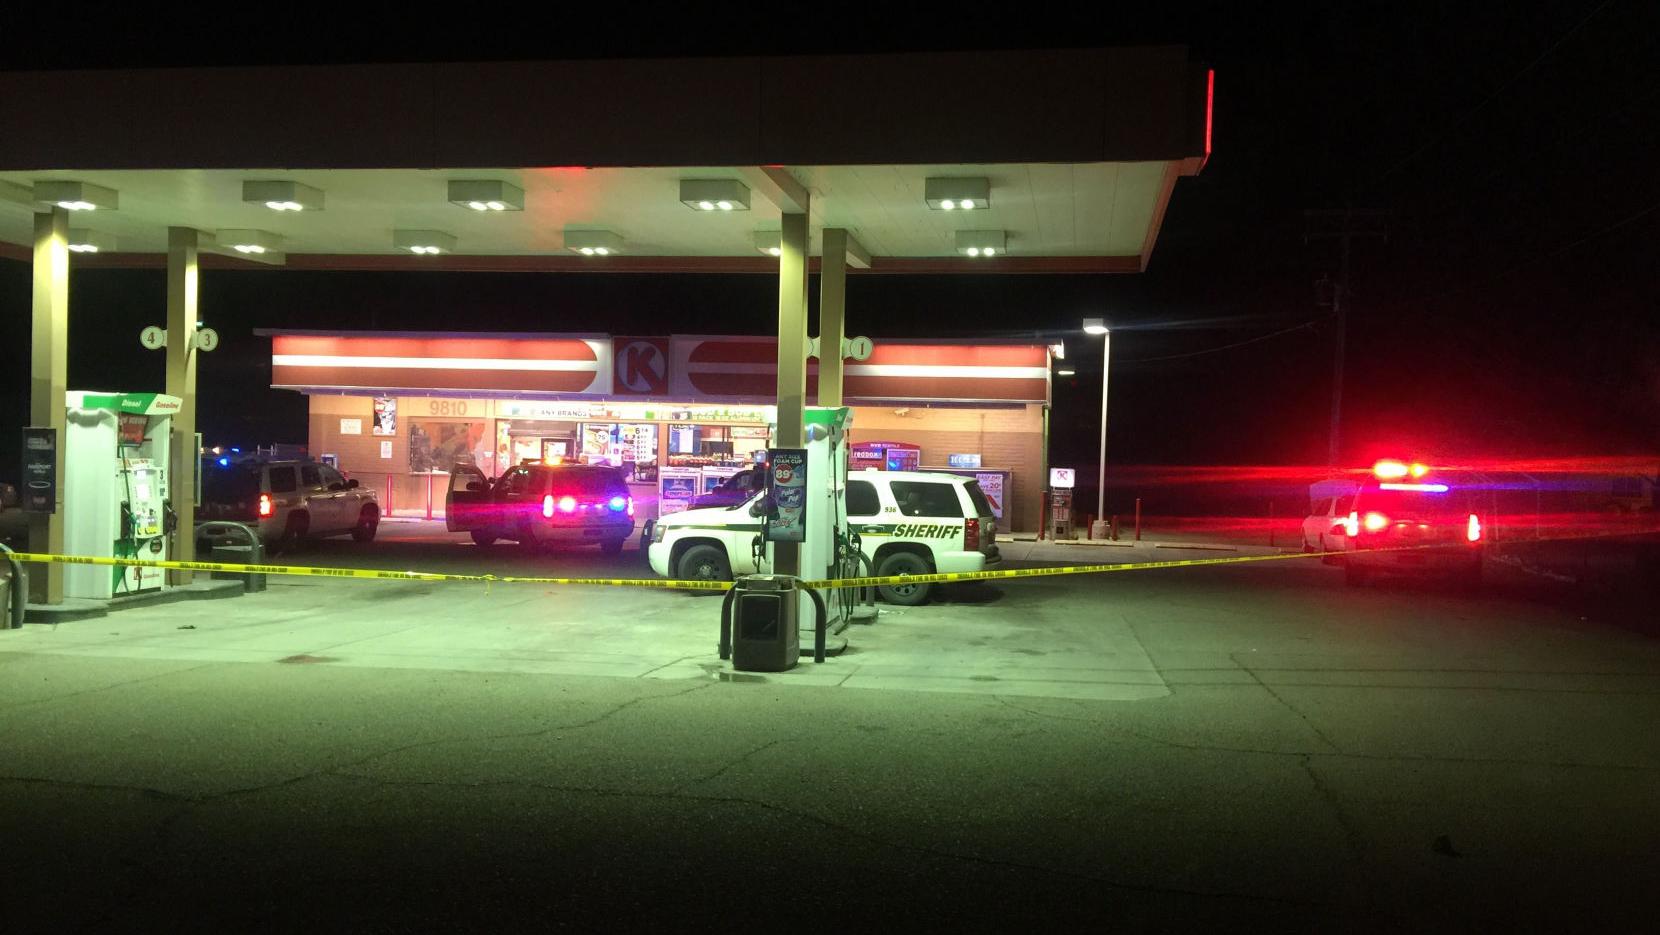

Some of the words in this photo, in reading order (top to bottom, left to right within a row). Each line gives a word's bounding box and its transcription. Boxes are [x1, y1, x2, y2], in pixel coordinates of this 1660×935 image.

[147, 332, 155, 344] 4
[204, 333, 211, 346] 3
[121, 399, 142, 408] Diesel
[155, 401, 179, 409] Gasoline
[429, 401, 467, 415] 9810
[853, 451, 878, 459] redbox
[894, 524, 962, 539] SHERIFF
